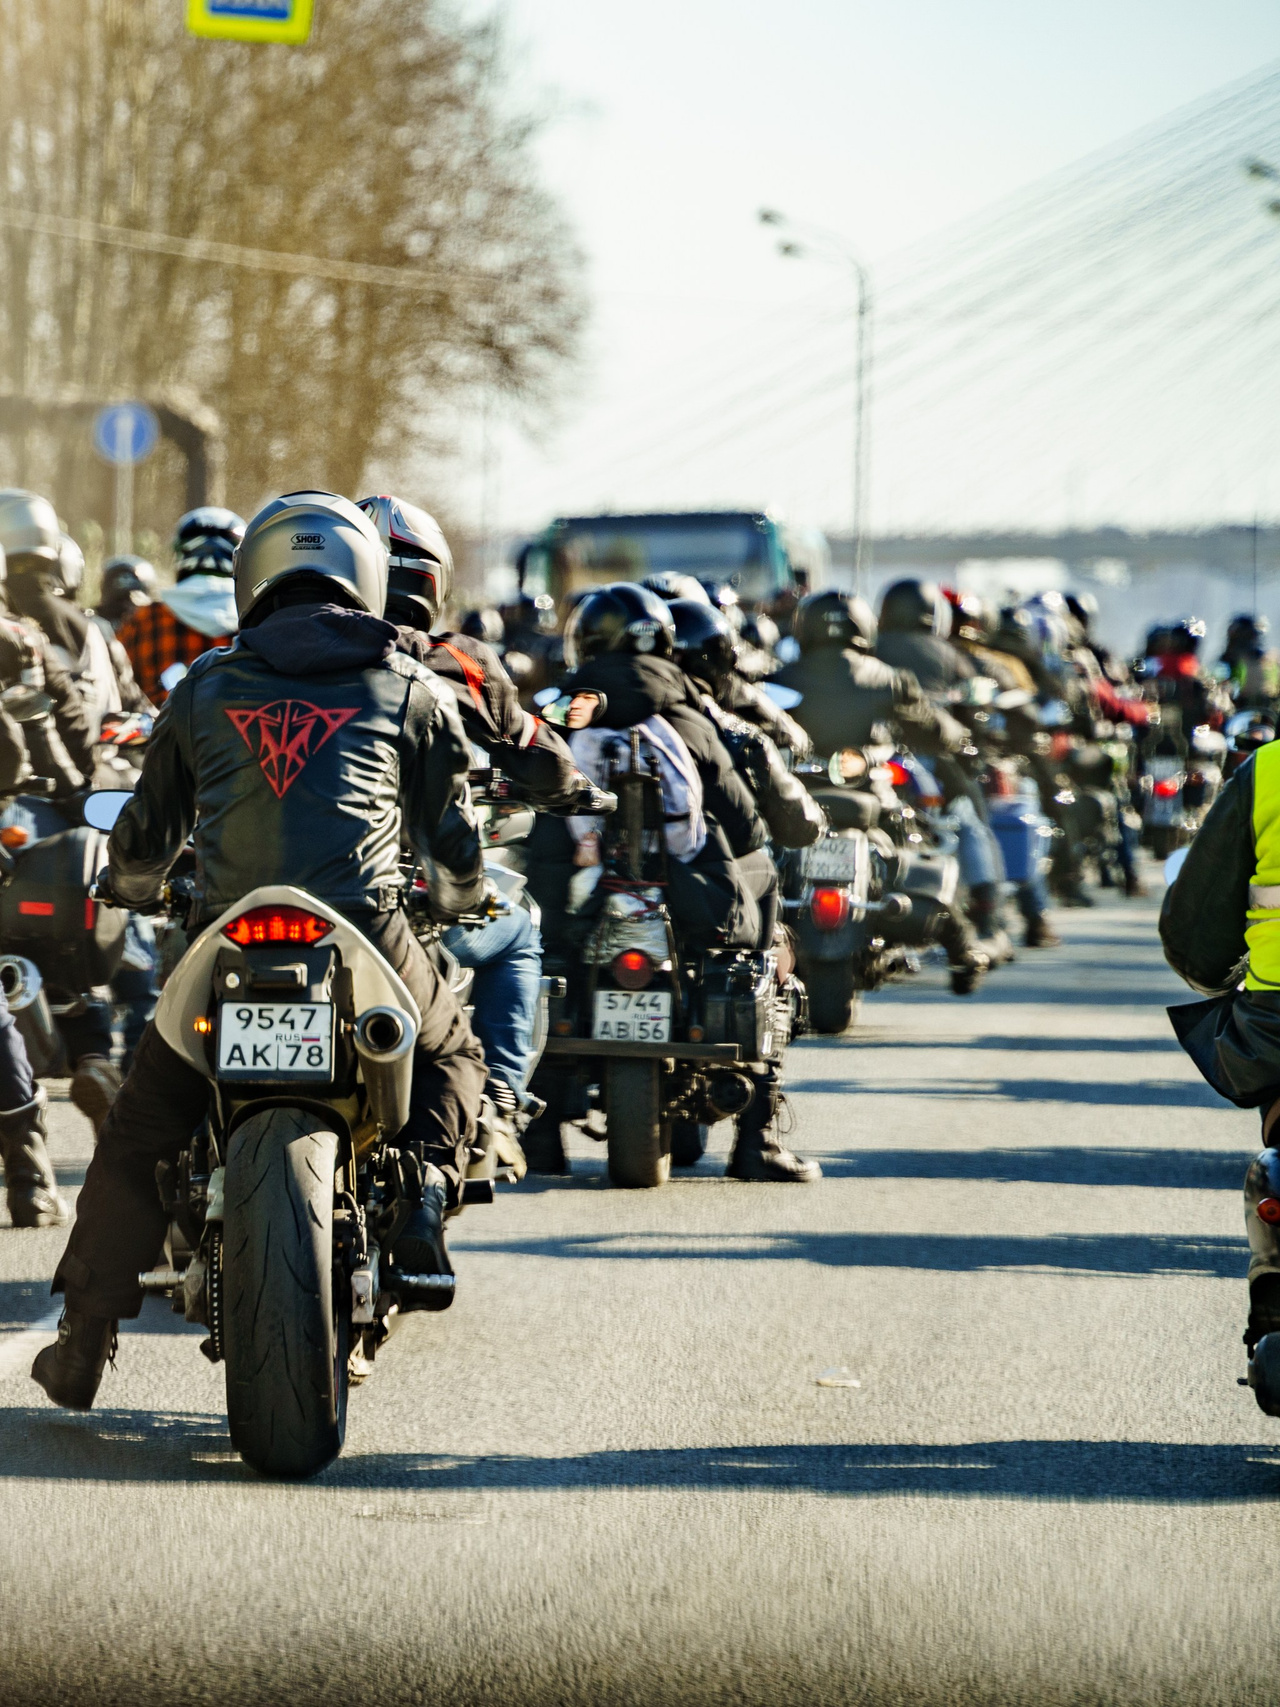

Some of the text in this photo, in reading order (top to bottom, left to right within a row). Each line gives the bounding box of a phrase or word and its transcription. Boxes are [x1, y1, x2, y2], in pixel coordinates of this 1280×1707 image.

[296, 535, 320, 543] SHOEI
[605, 993, 662, 1011] 5744
[236, 1008, 317, 1031] 9547
[276, 1033, 300, 1041] RUS
[601, 1021, 664, 1040] AB 56
[226, 1043, 324, 1067] AK 78
